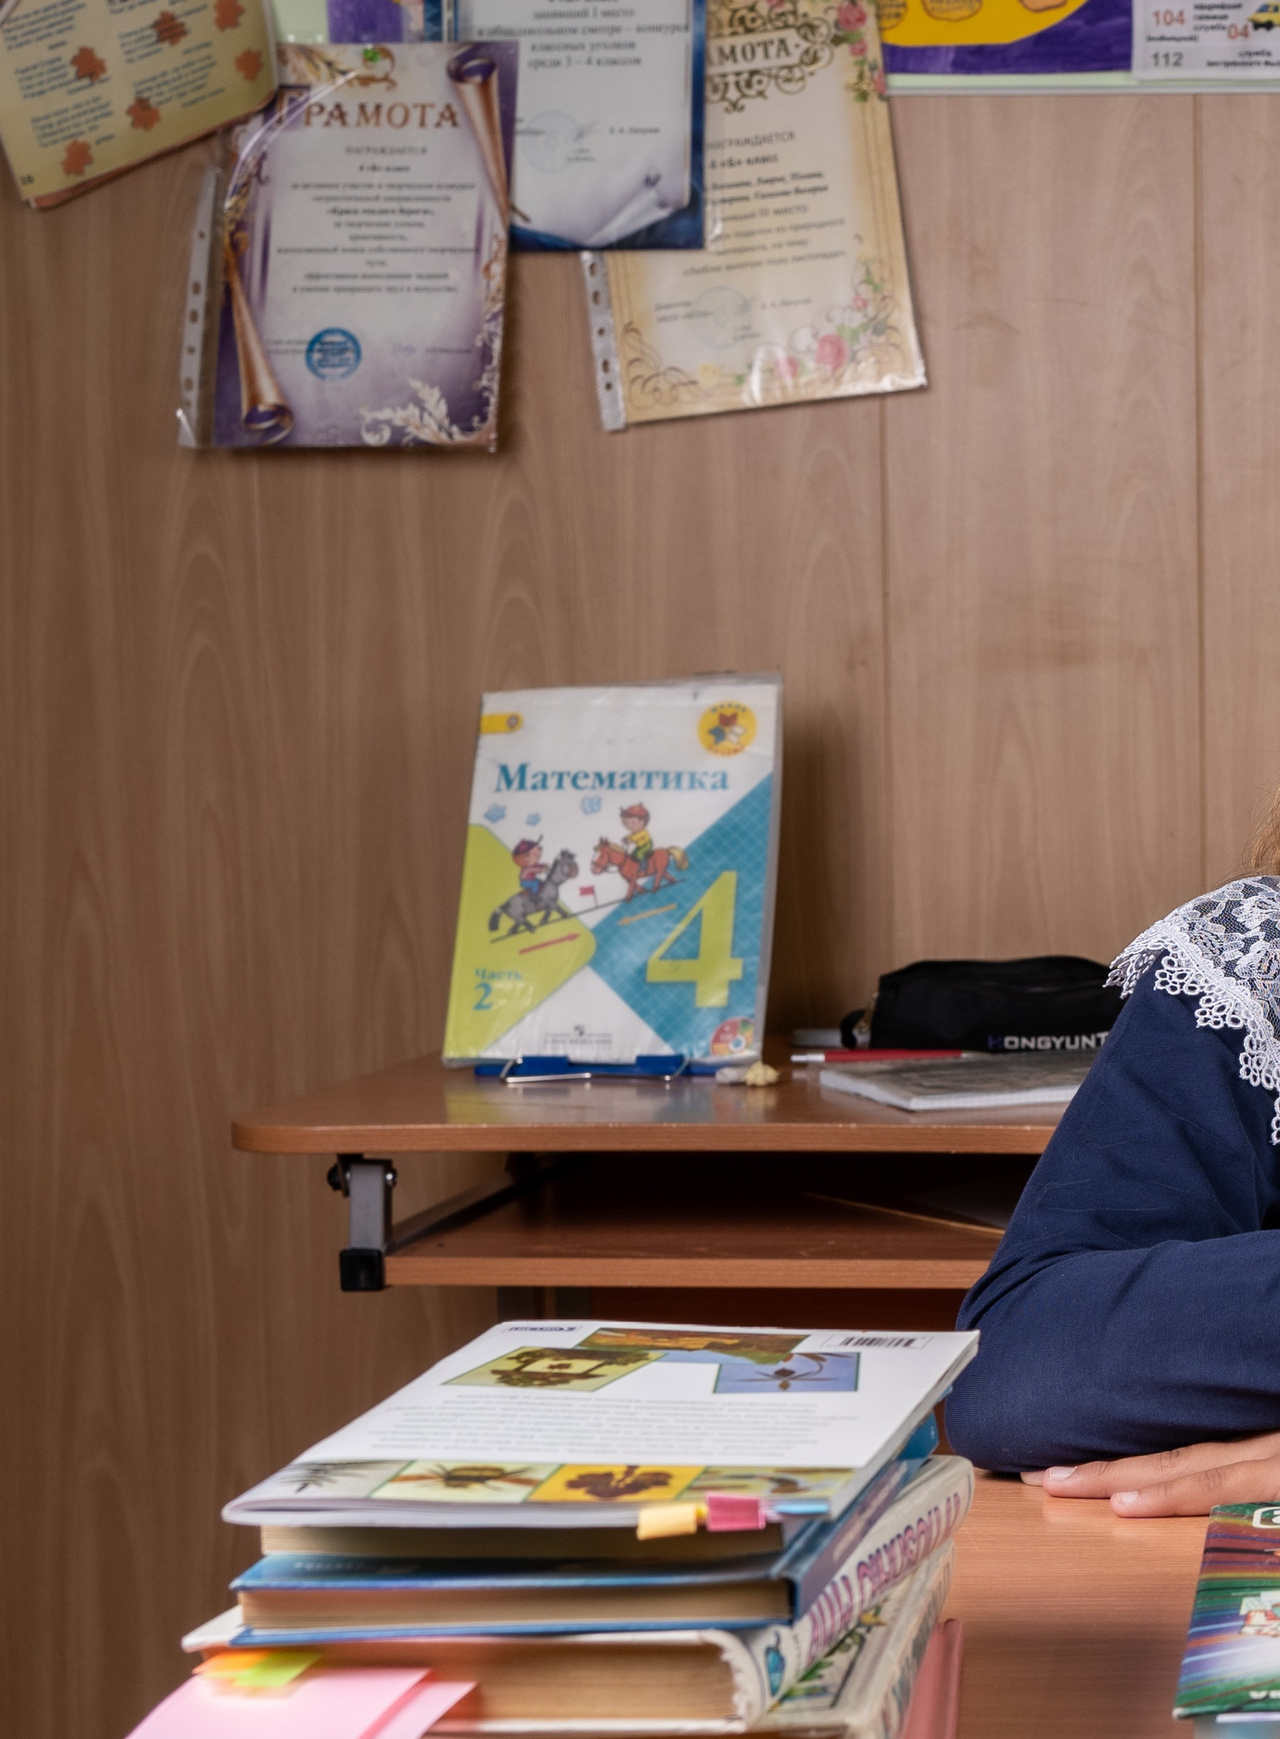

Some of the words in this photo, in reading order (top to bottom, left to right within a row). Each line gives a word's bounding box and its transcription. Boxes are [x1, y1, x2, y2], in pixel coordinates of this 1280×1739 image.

[1153, 10, 1186, 26] 104
[1227, 24, 1250, 40] 04
[1151, 52, 1185, 68] 112
[493, 762, 729, 793] Математика
[646, 869, 744, 1008] 4
[474, 967, 524, 981] Часть
[472, 982, 493, 1011] 2
